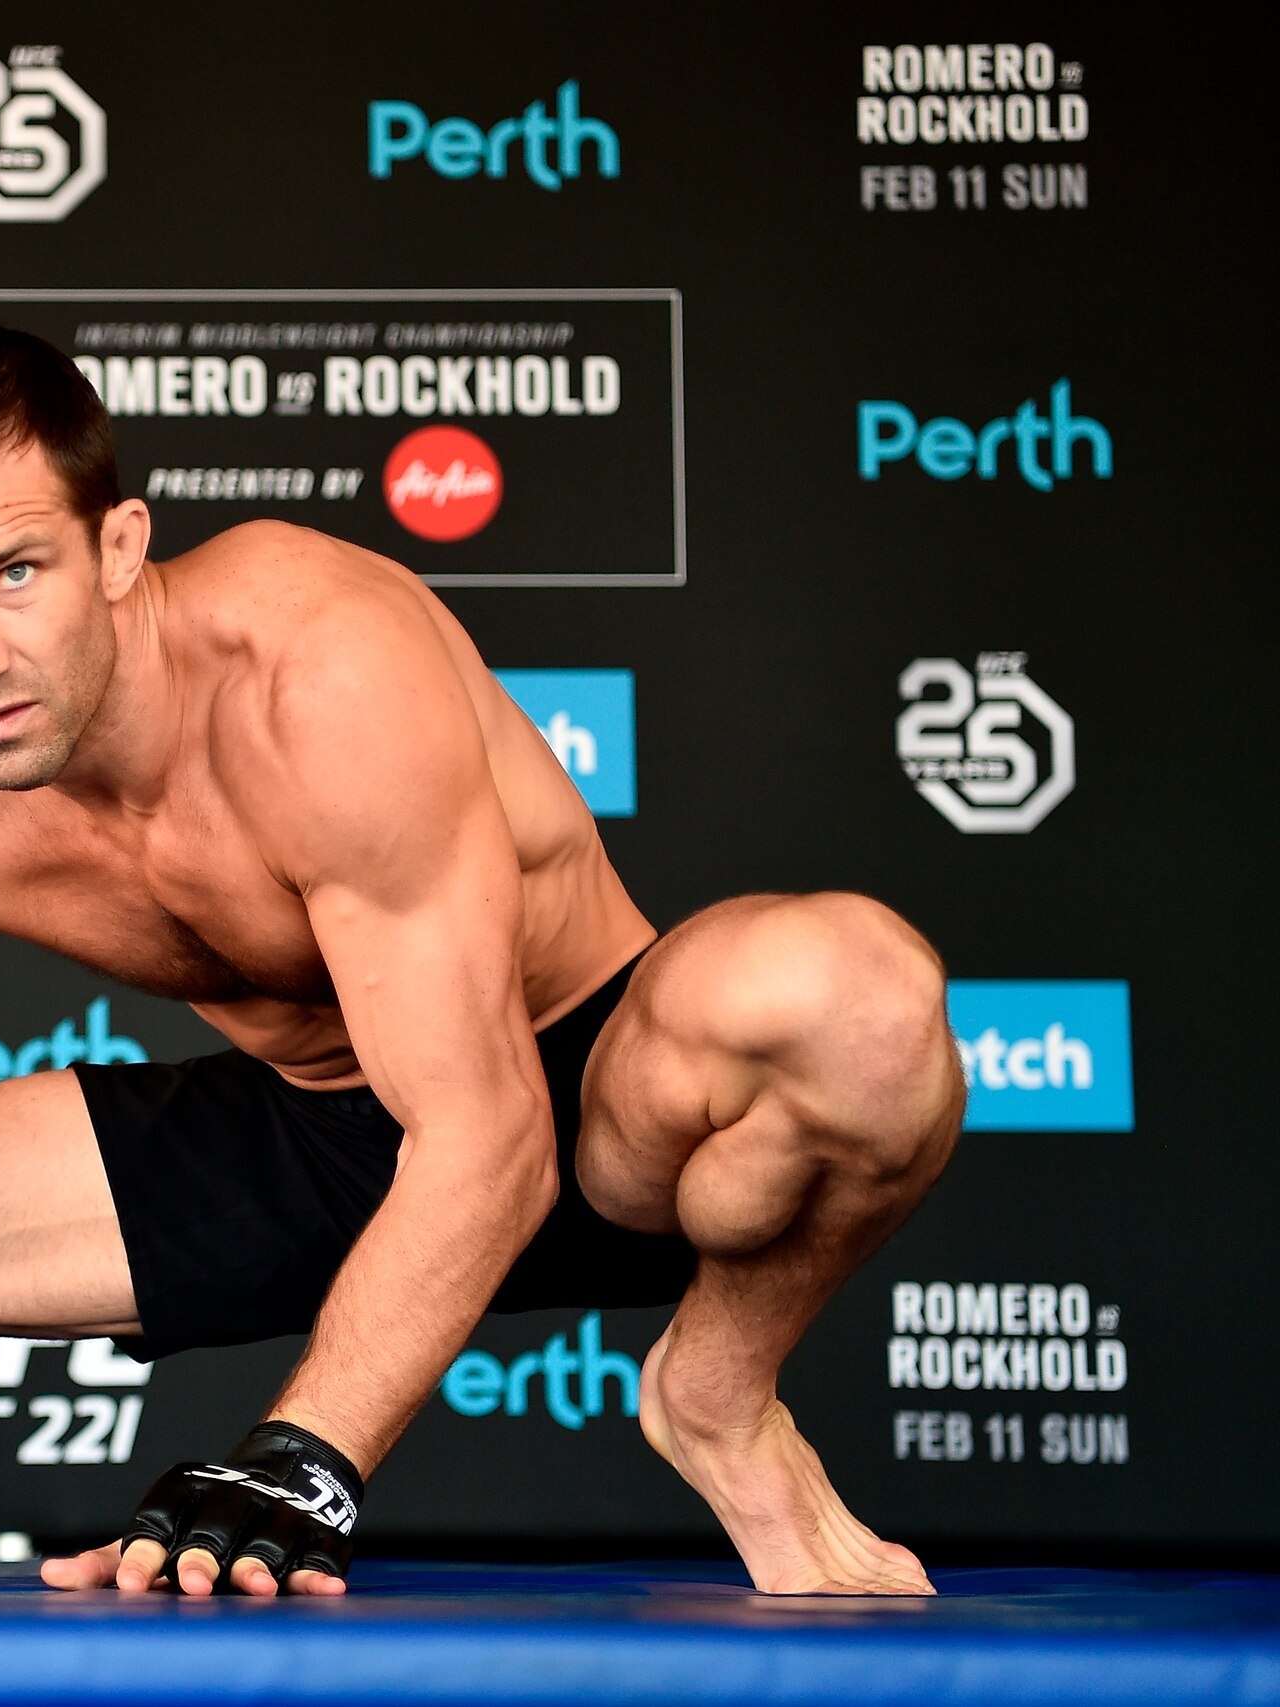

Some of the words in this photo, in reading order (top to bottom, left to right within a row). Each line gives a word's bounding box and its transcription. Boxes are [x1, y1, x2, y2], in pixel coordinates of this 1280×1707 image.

[862, 43, 1055, 93] ROMERO
[368, 78, 620, 191] Perth
[857, 94, 1090, 144] ROCKHOLD
[860, 165, 937, 212] FEB
[947, 166, 987, 210] 11
[1002, 163, 1088, 211] SUN
[73, 355, 268, 417] OMERO
[323, 354, 621, 417] ROCKHOLD
[856, 376, 1114, 493] Perth
[146, 467, 316, 500] PRESENTED
[321, 467, 364, 500] BY
[391, 458, 496, 508] AirAsia
[896, 657, 1076, 835] 25
[956, 1021, 1094, 1090] tch
[892, 1281, 1090, 1337] ROMERO
[441, 1309, 641, 1431] erth
[888, 1335, 1128, 1392] ROCKHOLD
[16, 1394, 145, 1466] 221
[893, 1410, 973, 1462] FEB
[984, 1412, 1025, 1463] 11
[1040, 1412, 1129, 1465] SUN
